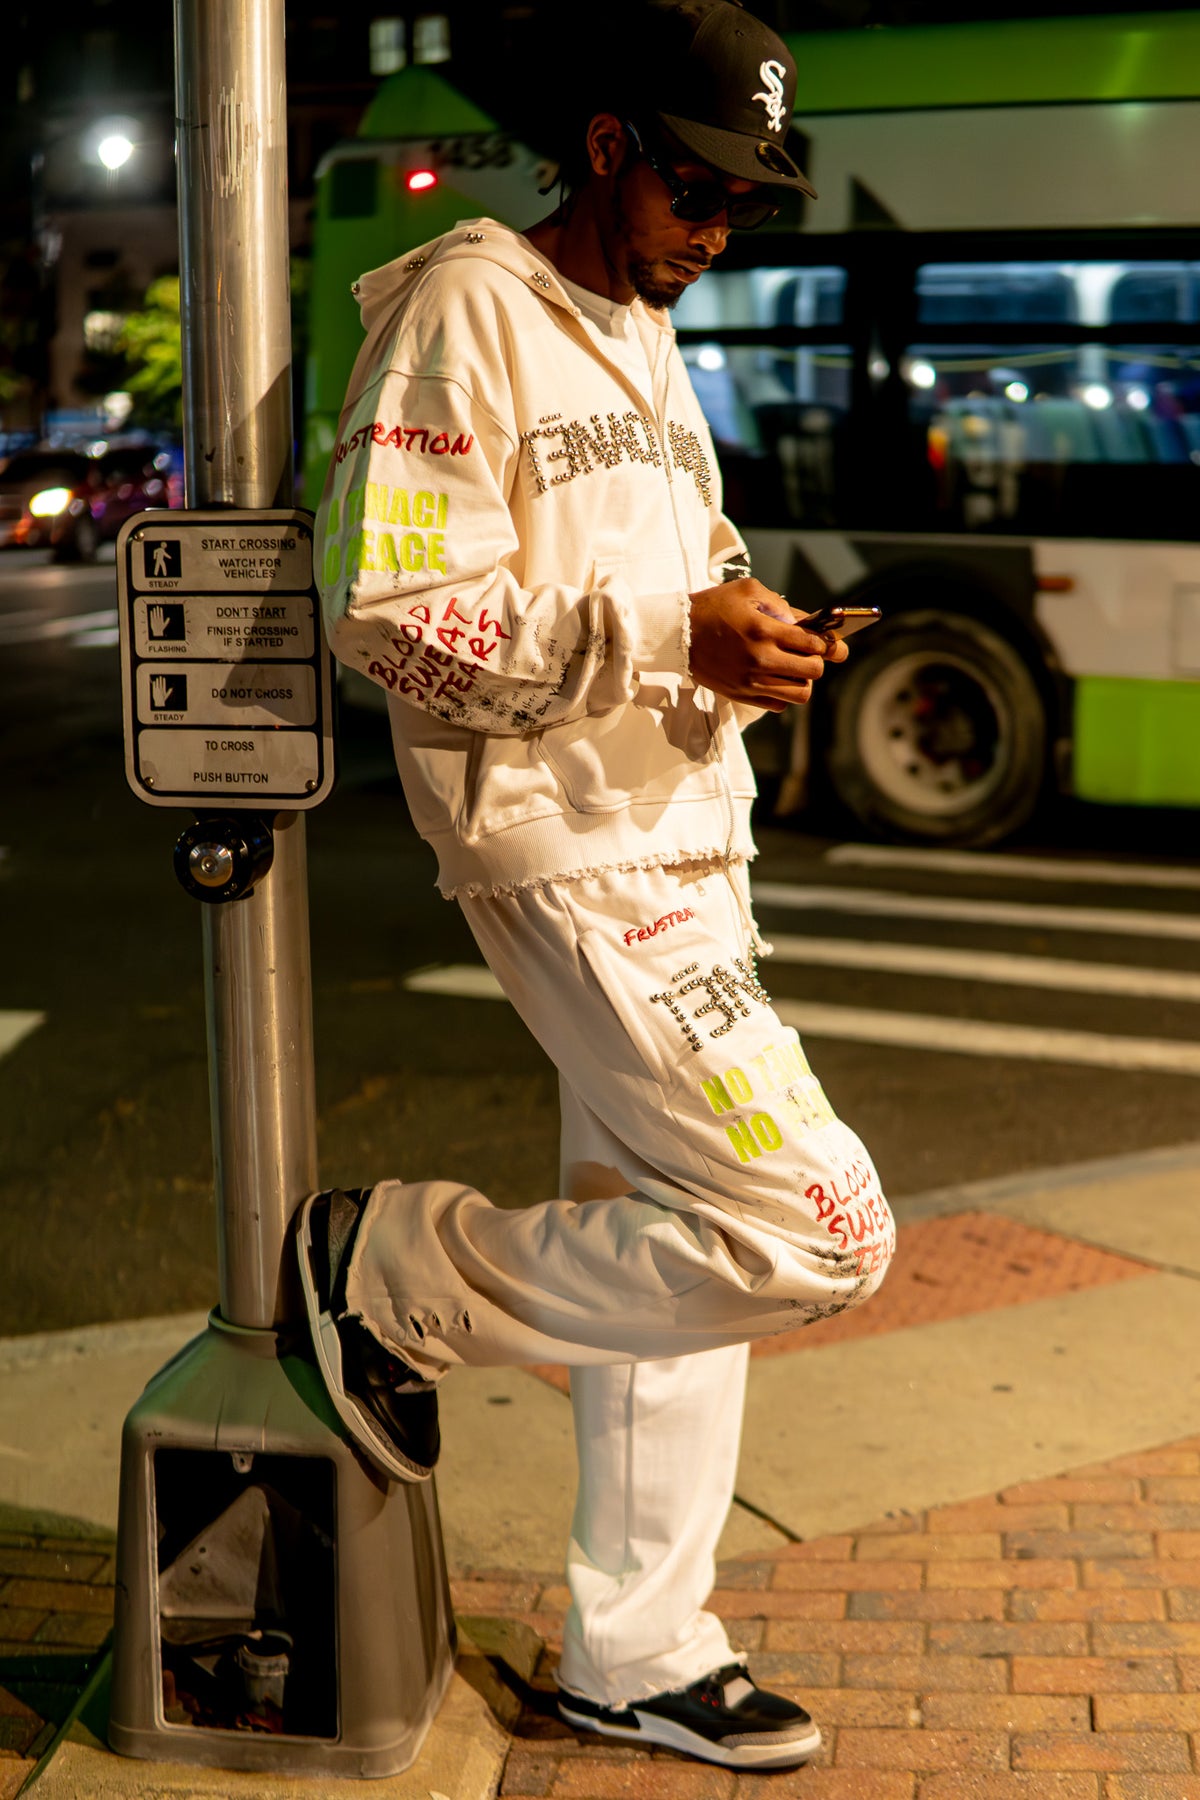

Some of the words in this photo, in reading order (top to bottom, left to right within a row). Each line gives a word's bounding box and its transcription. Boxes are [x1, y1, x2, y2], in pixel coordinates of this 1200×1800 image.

[201, 539, 235, 550] START
[239, 539, 296, 550] CROSSING
[218, 558, 256, 568] WATCH
[259, 558, 281, 568] FOR
[224, 569, 276, 579] VEHICLES
[149, 580, 178, 588] STEADY
[216, 607, 249, 618] DON'T
[252, 607, 286, 619] START
[207, 627, 240, 637] FINISH
[243, 627, 299, 637] CROSSING
[148, 645, 187, 653] FLASHING
[223, 638, 232, 647] IF
[235, 638, 284, 648] STARTED
[368, 605, 430, 690] BLOOD
[399, 598, 472, 701] SWEAT
[434, 609, 511, 707] TEARS
[211, 688, 227, 699] DO
[230, 688, 252, 699] NOT
[255, 688, 293, 700] CROSS
[153, 714, 185, 722] STEADY
[205, 740, 218, 751] TO
[220, 741, 255, 752] CROSS
[193, 772, 222, 783] PUSH
[225, 773, 269, 784] BUTTON
[700, 1066, 754, 1116] NO
[724, 1111, 784, 1164] NO
